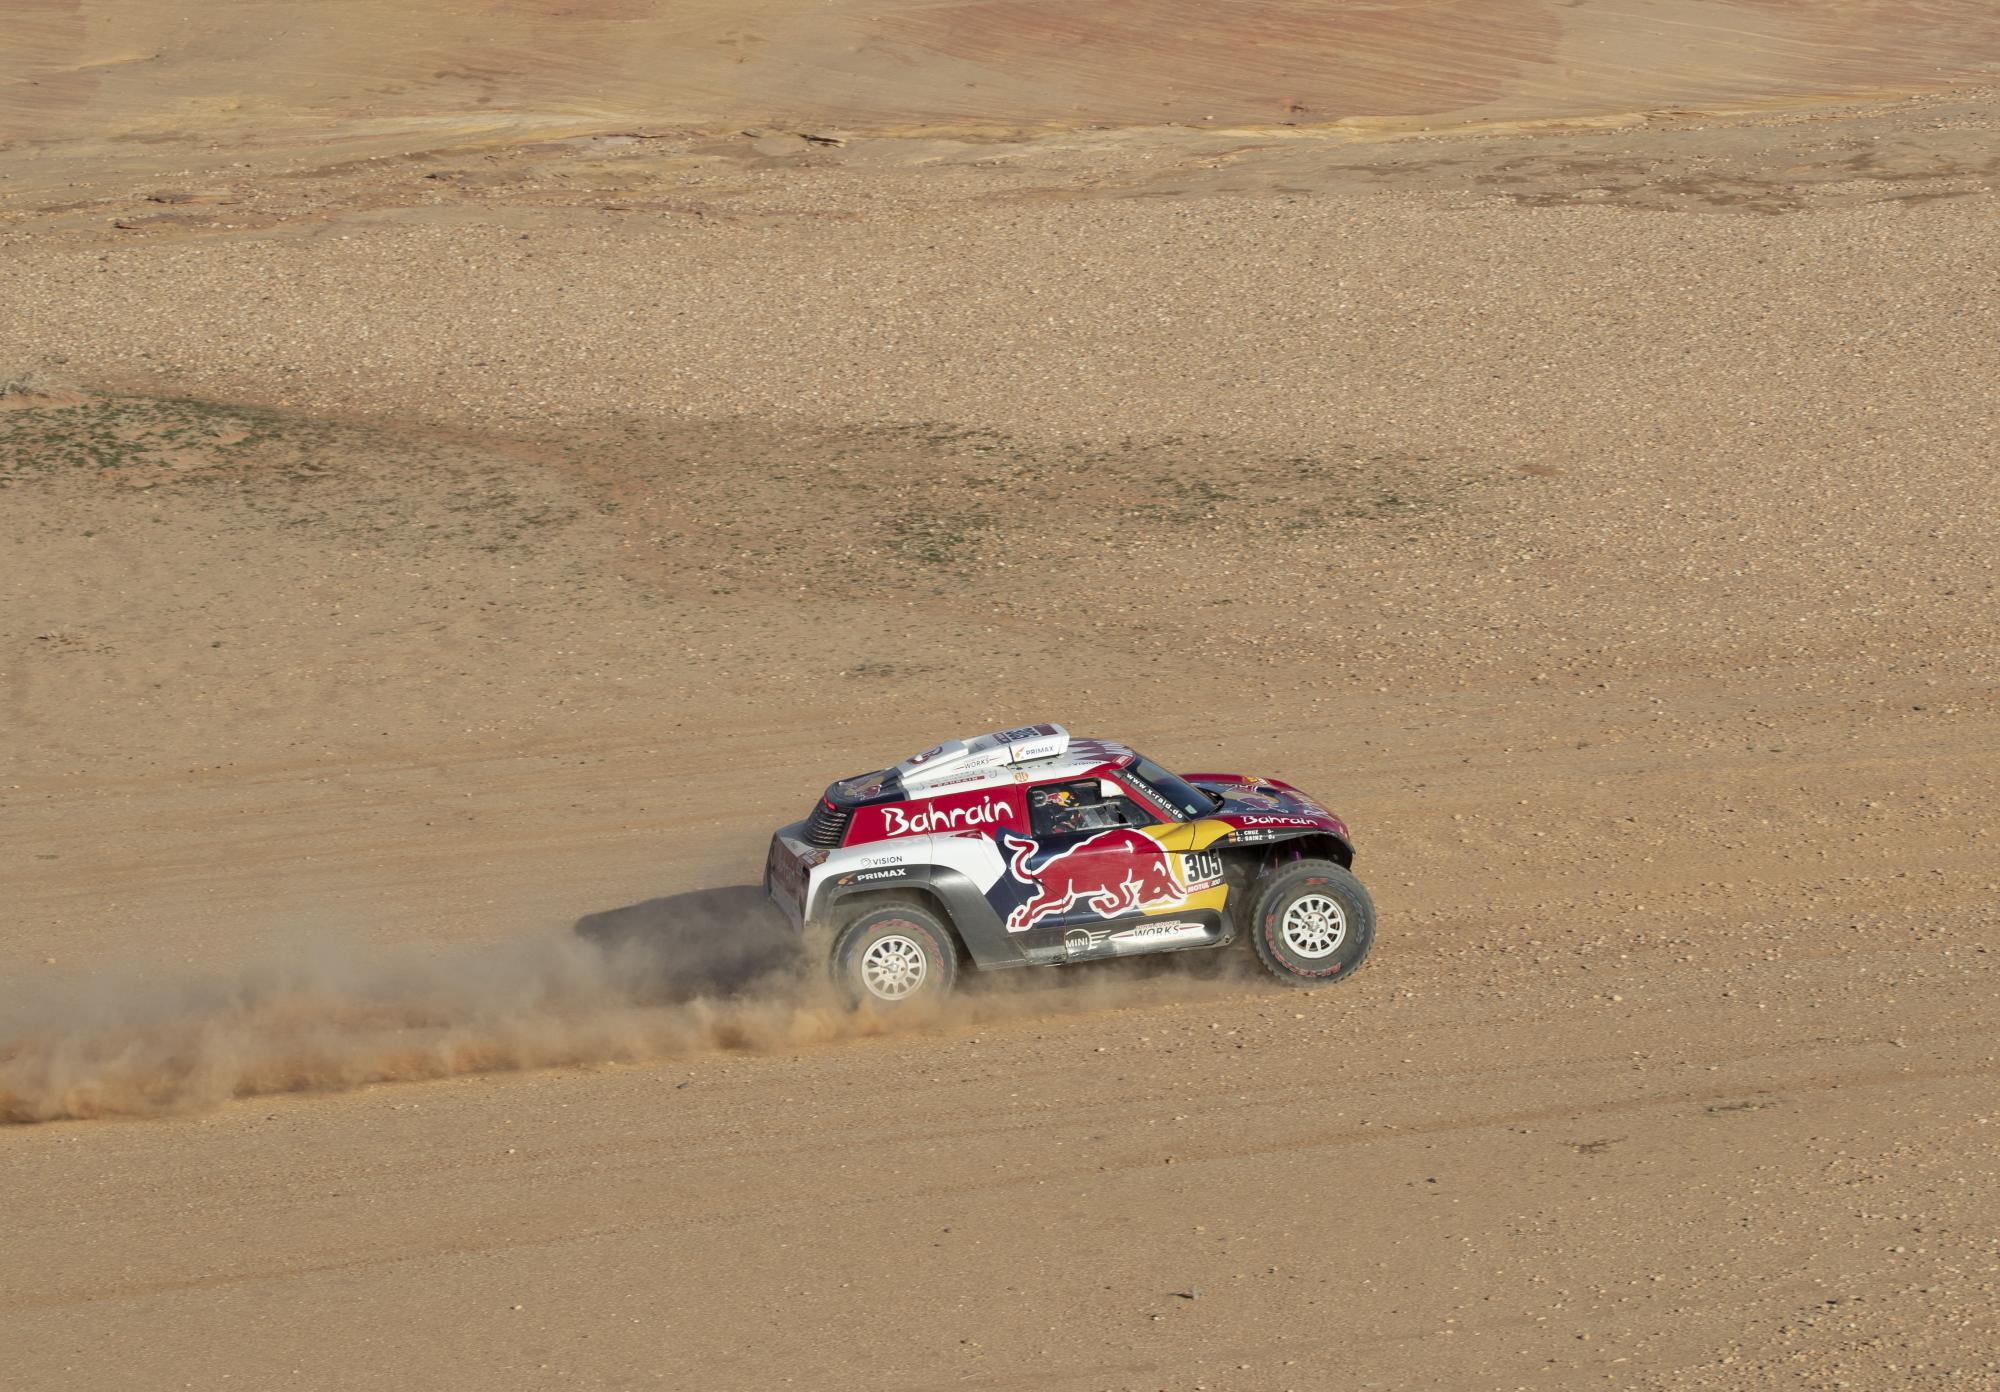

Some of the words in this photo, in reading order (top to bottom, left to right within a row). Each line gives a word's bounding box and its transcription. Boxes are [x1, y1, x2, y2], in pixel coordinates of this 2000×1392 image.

[1026, 745, 1054, 755] PRIMAX
[1126, 773, 1183, 819] www.x-raid.de
[881, 796, 1013, 836] Bahrain
[1240, 815, 1318, 826] Bahrain
[872, 856, 903, 865] VISION
[1185, 849, 1221, 882] 305
[857, 868, 906, 881] PRIMAX
[1135, 925, 1179, 936] WORKS
[1065, 937, 1088, 948] MINI
